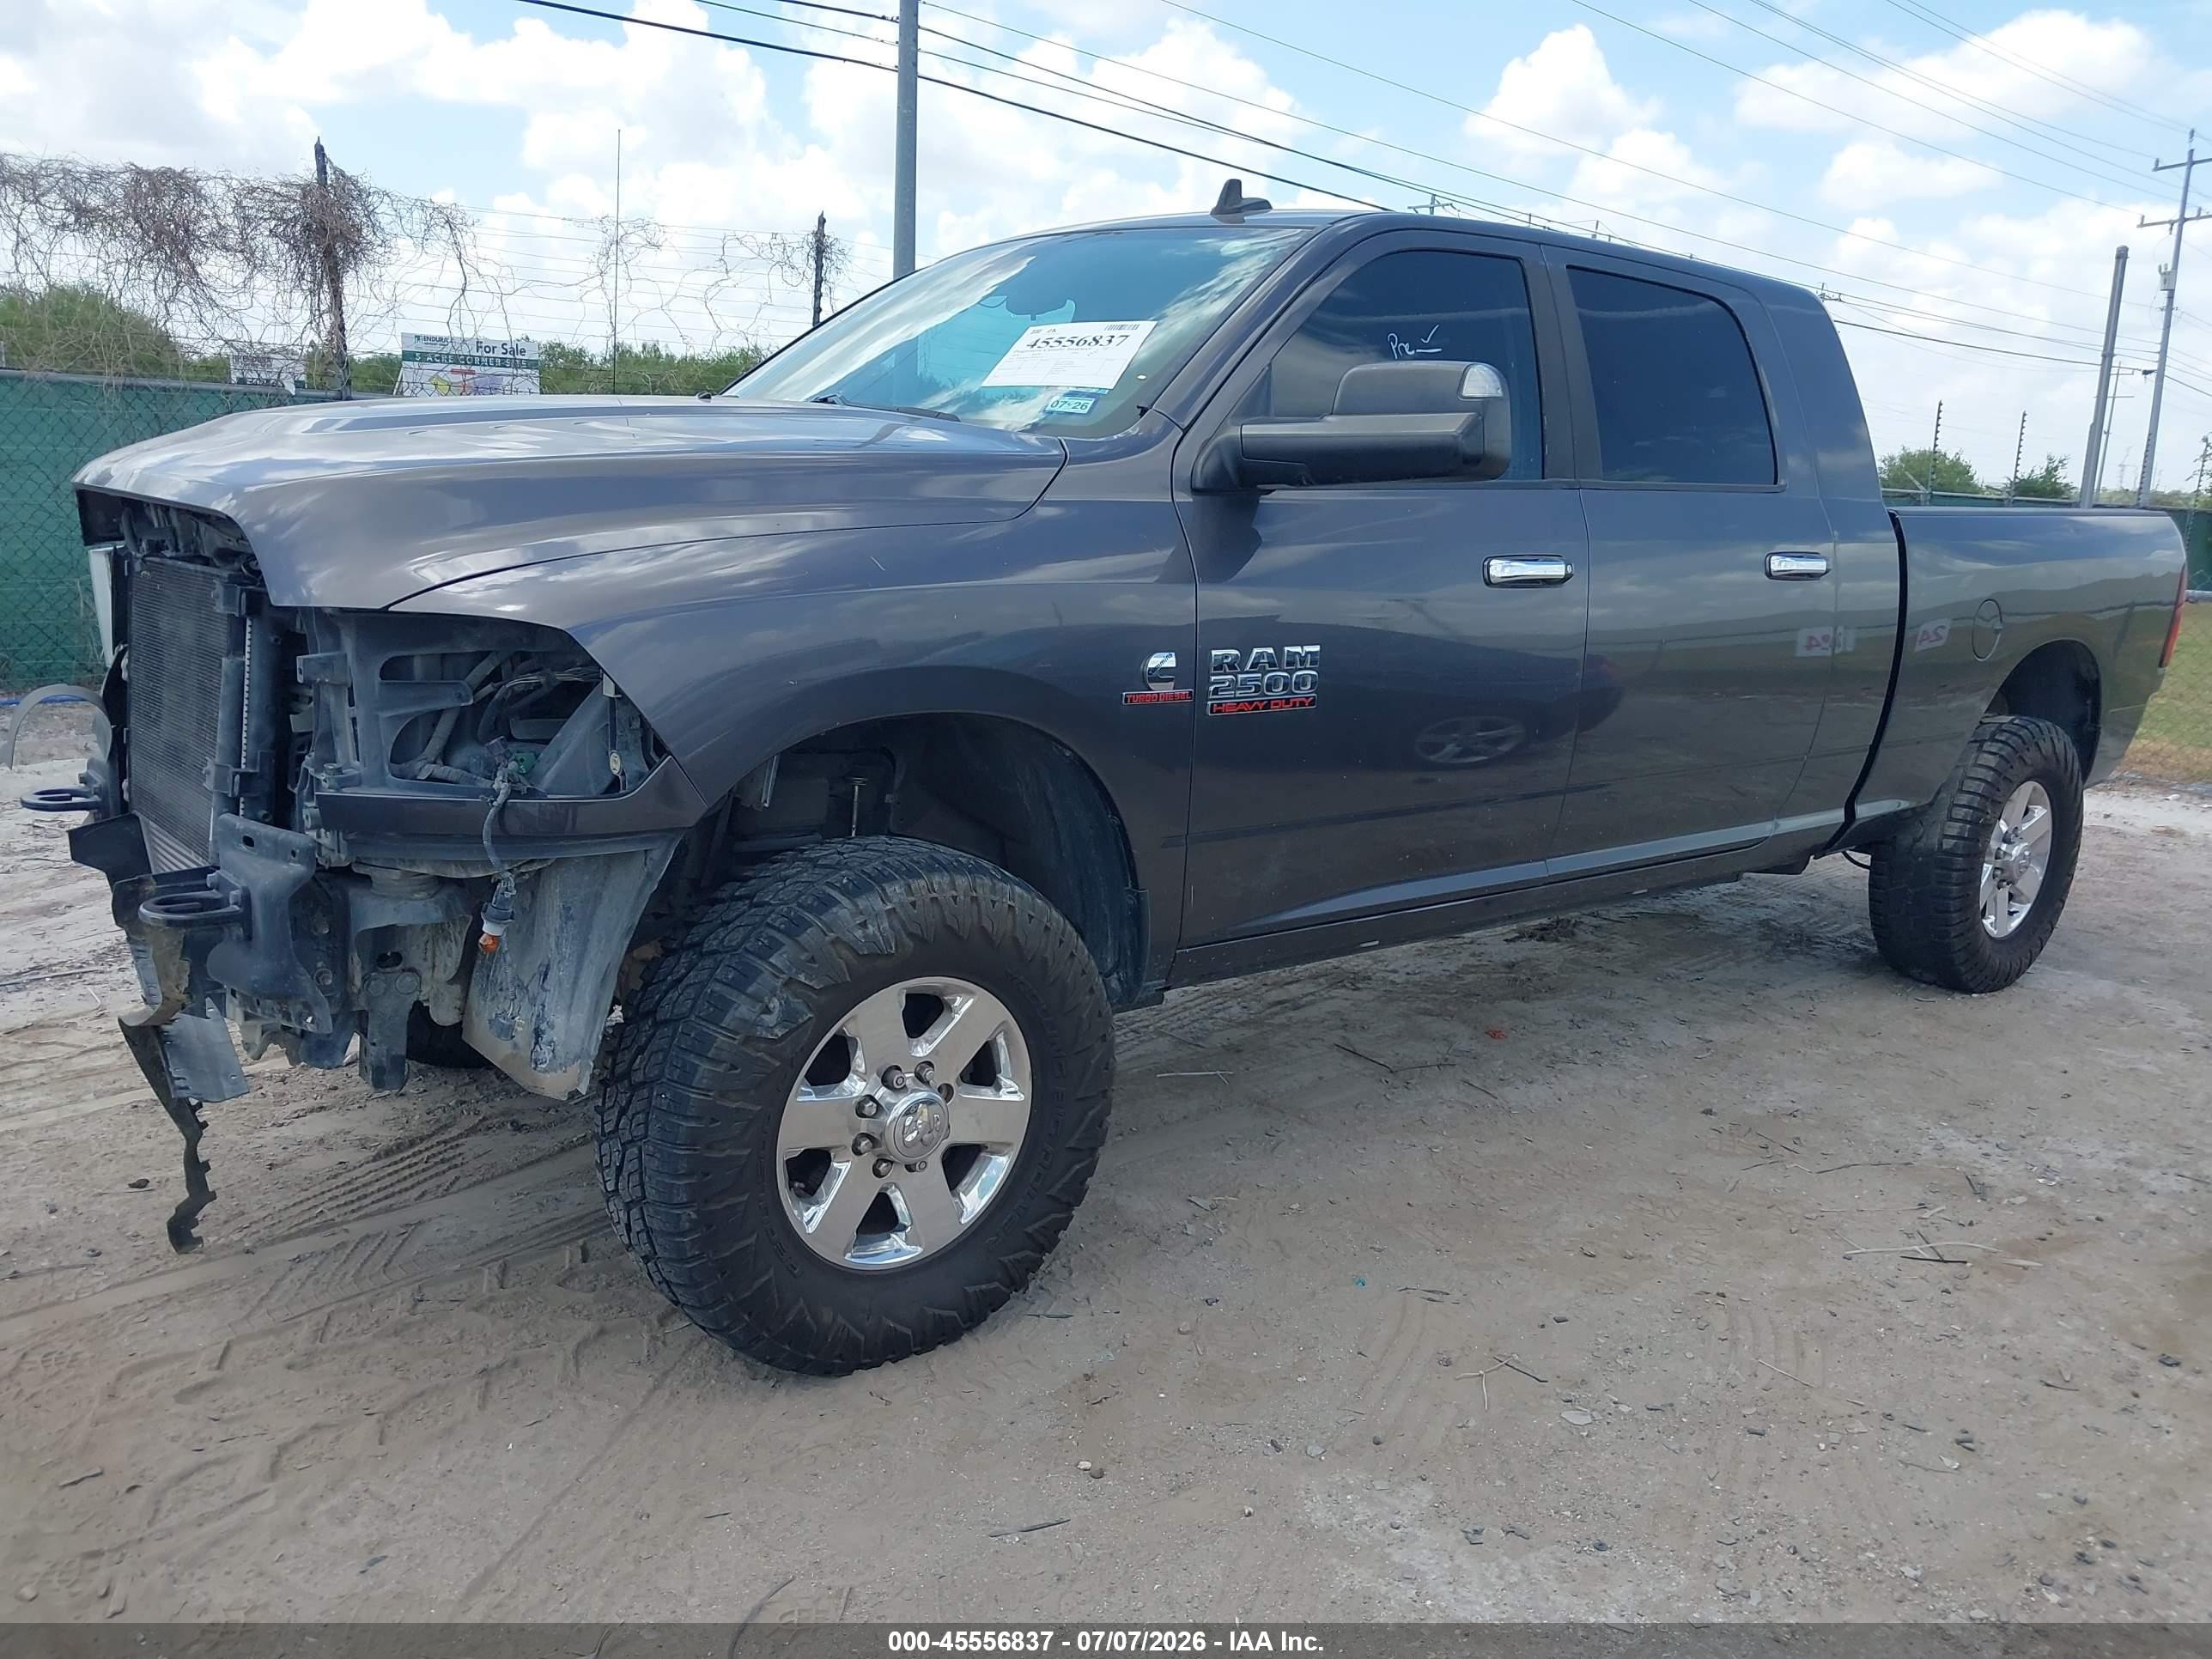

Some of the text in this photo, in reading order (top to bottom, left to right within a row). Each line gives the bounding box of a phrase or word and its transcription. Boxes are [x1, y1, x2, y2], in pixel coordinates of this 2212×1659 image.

[476, 341, 527, 357] For Sale
[1028, 334, 1129, 349] 45556837
[426, 353, 455, 364] ACRE
[459, 356, 501, 368] CORNER
[1210, 645, 1321, 673] RAM
[1208, 670, 1319, 699] 2500
[1126, 691, 1192, 703] TURBO DIESEL
[1212, 696, 1316, 714] HEAVY DUTY
